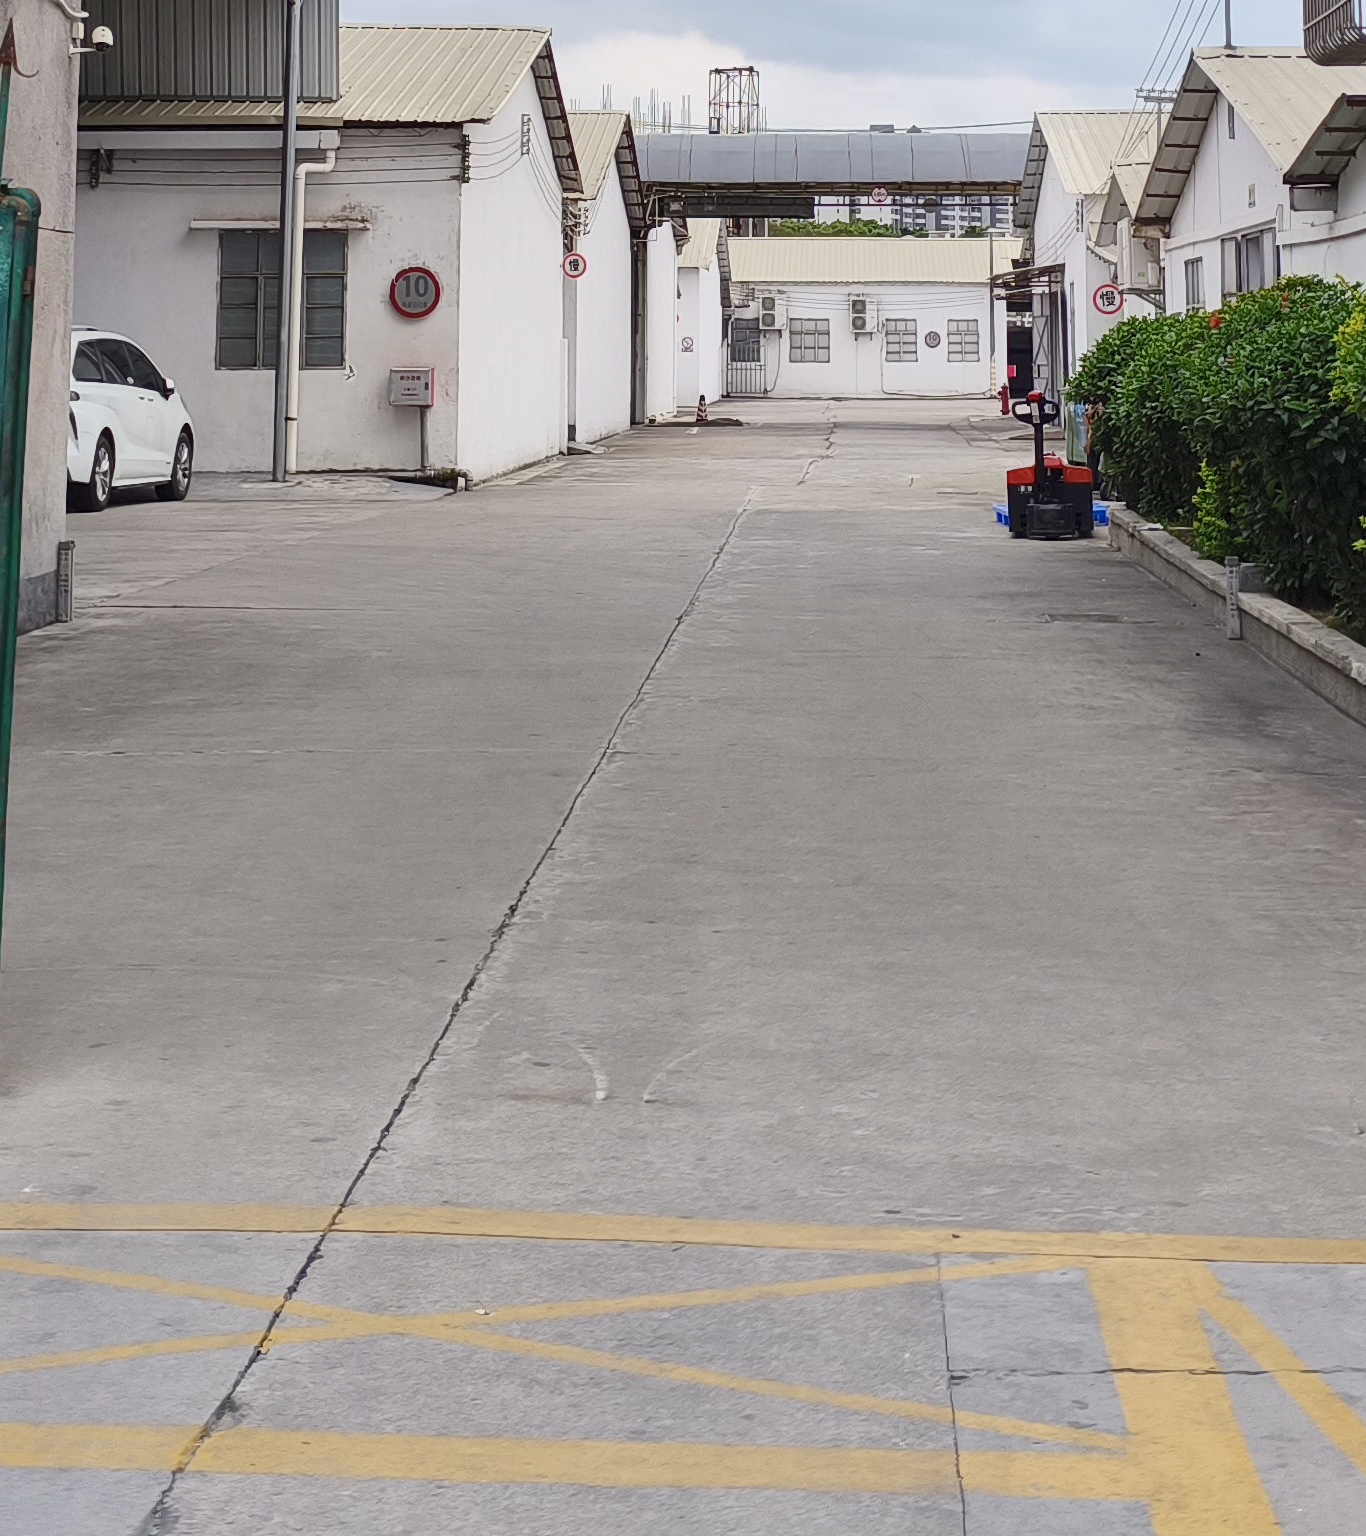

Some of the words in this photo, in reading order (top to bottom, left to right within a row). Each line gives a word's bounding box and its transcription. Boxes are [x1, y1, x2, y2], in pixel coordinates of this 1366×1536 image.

[569, 259, 579, 271] 慢
[402, 275, 429, 298] 10
[1100, 290, 1116, 307] 慢
